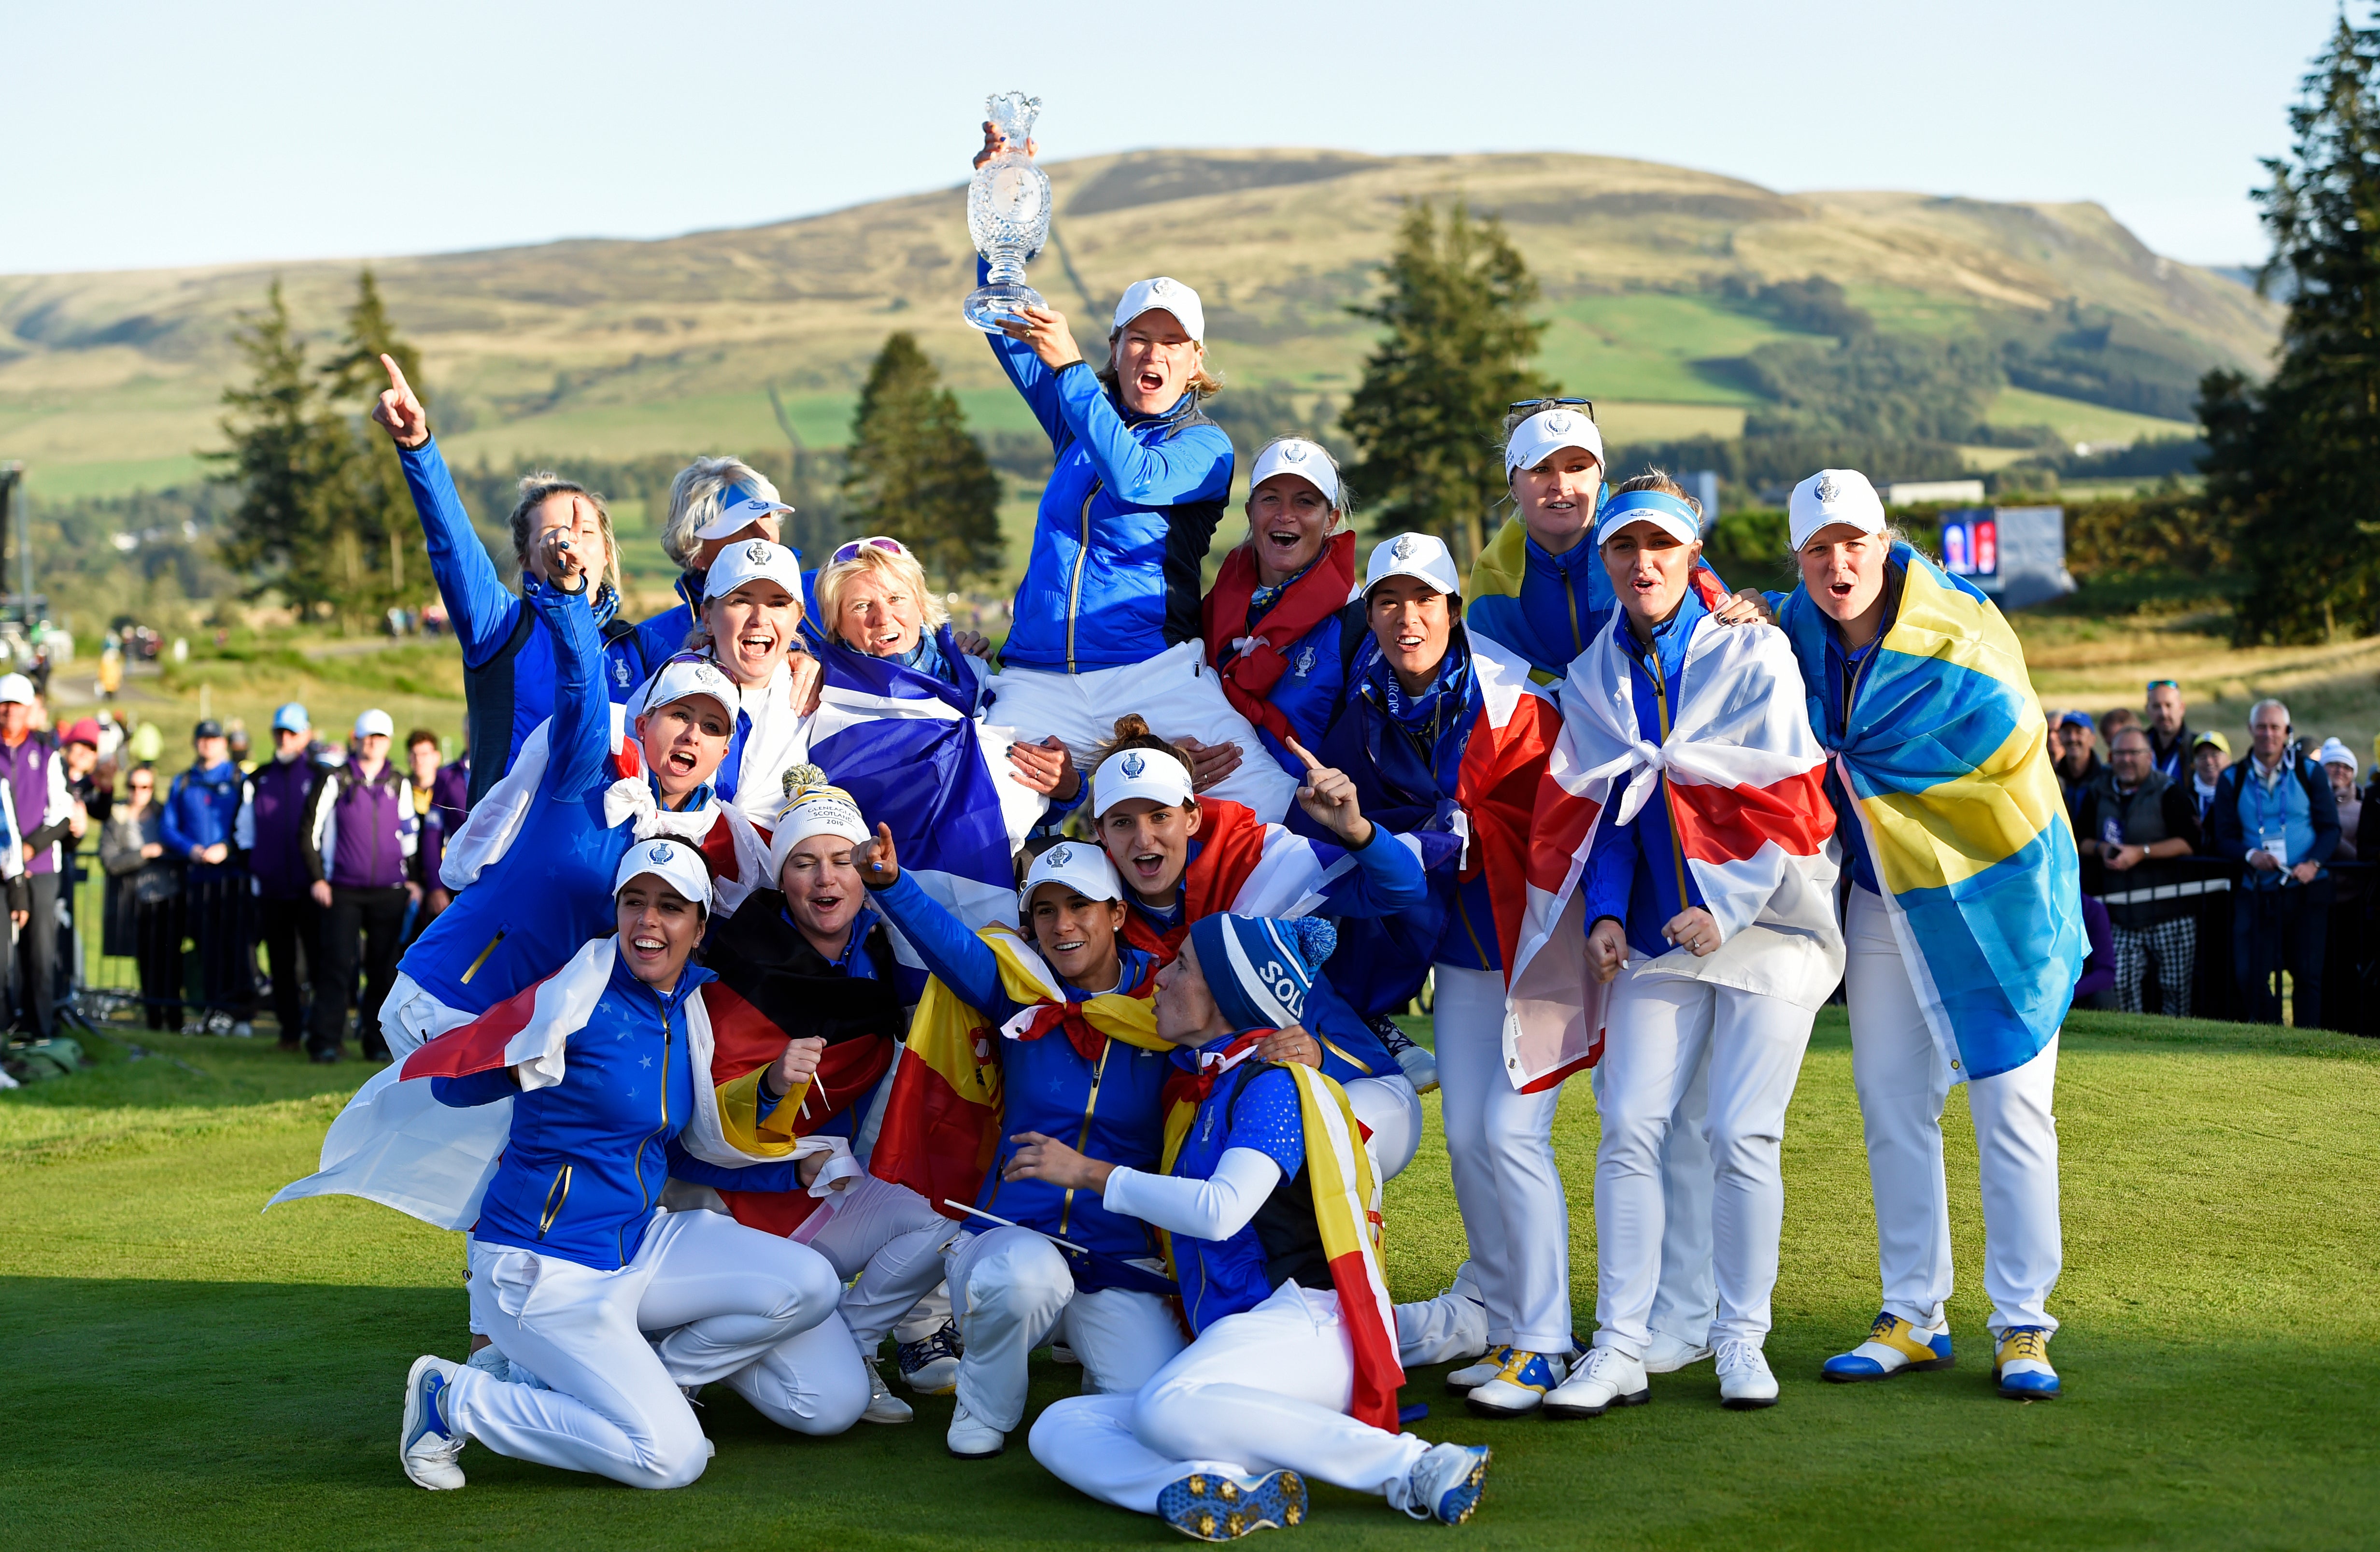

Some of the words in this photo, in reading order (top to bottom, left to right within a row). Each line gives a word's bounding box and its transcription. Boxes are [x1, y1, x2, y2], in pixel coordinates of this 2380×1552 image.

[808, 806, 855, 820] GLENEAGLES
[813, 811, 852, 823] SCOTLAND
[425, 1380, 436, 1394] FJ
